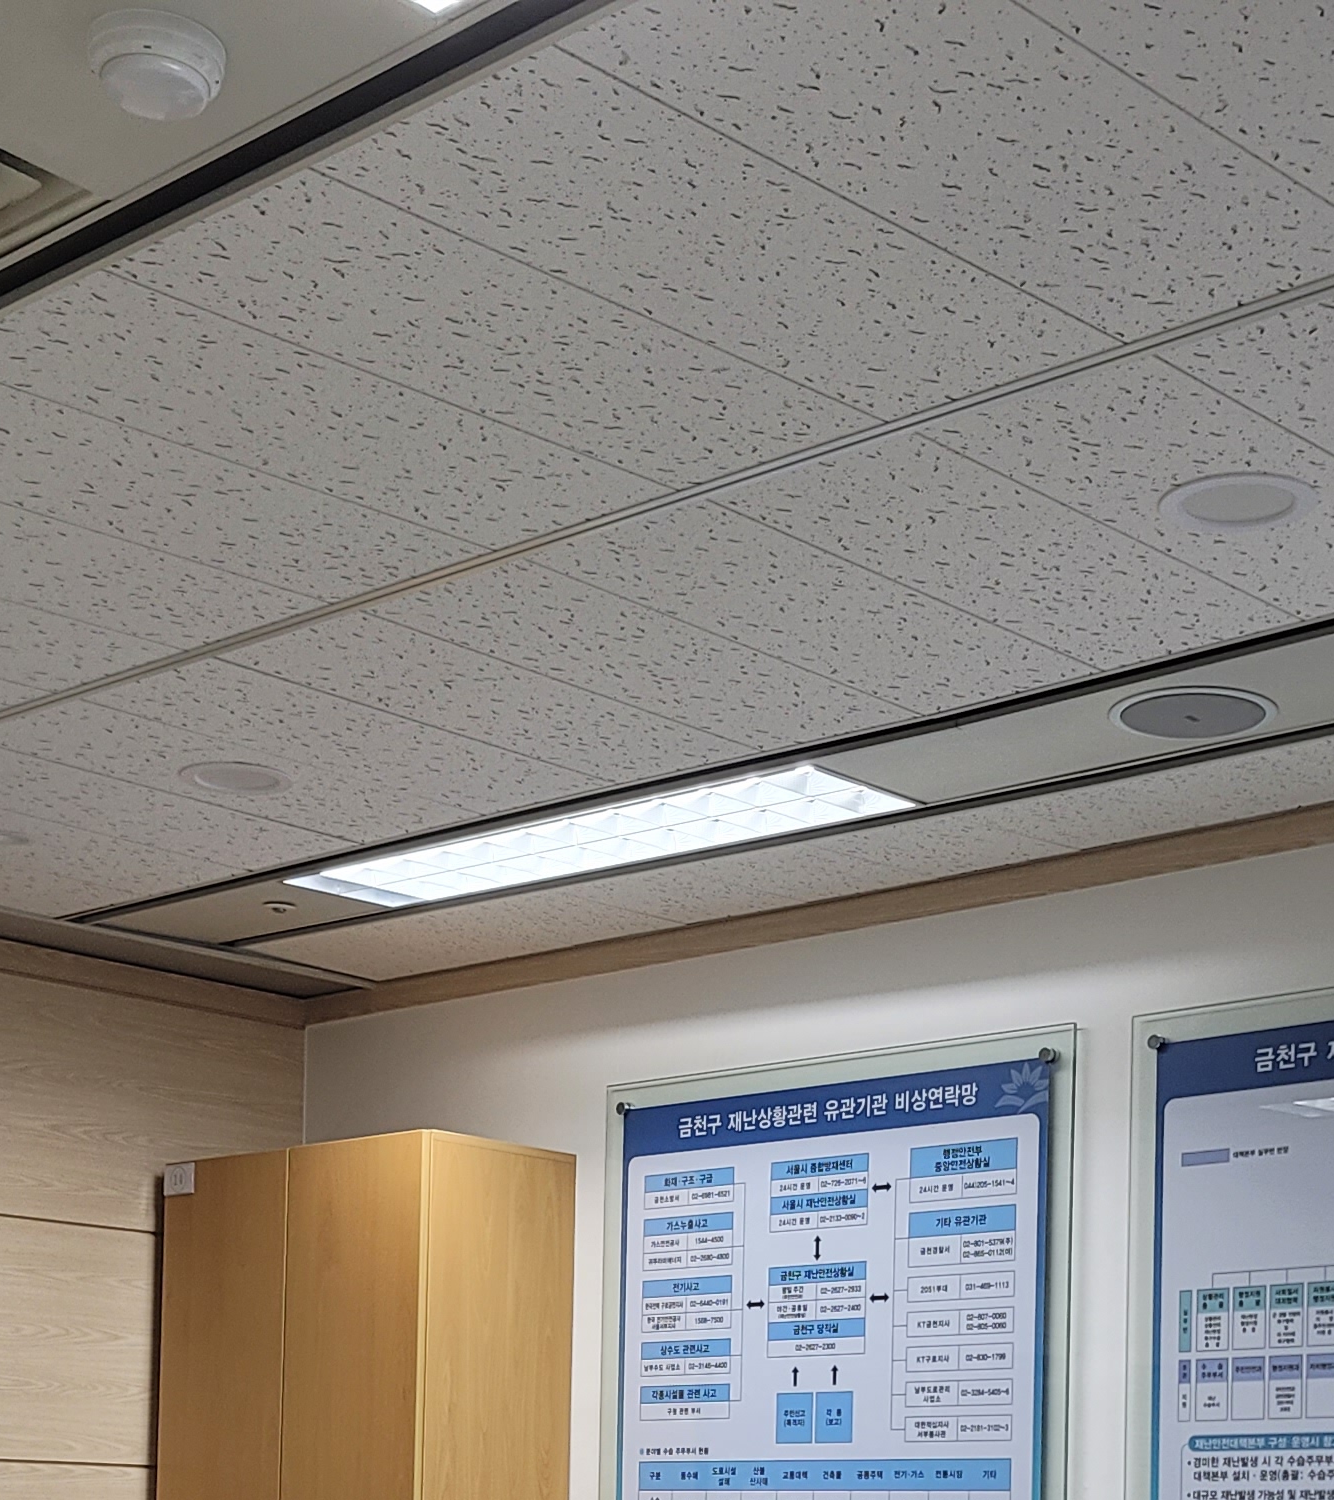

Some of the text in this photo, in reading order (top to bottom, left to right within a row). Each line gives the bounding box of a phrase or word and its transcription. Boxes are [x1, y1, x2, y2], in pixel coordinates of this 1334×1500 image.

[1254, 1044, 1318, 1075] 금천구
[678, 1081, 979, 1139] 금천구 재난상황관련 유관기관 비상연락망
[935, 1214, 987, 1228] 기타 유관기관
[780, 1266, 855, 1281] 금천구 재난안전상황실
[672, 1282, 700, 1293] 전기사고
[793, 1325, 815, 1336] 금천구
[703, 1389, 717, 1398] 사고
[1261, 1456, 1271, 1467] 시
[982, 1470, 997, 1479] 기타
